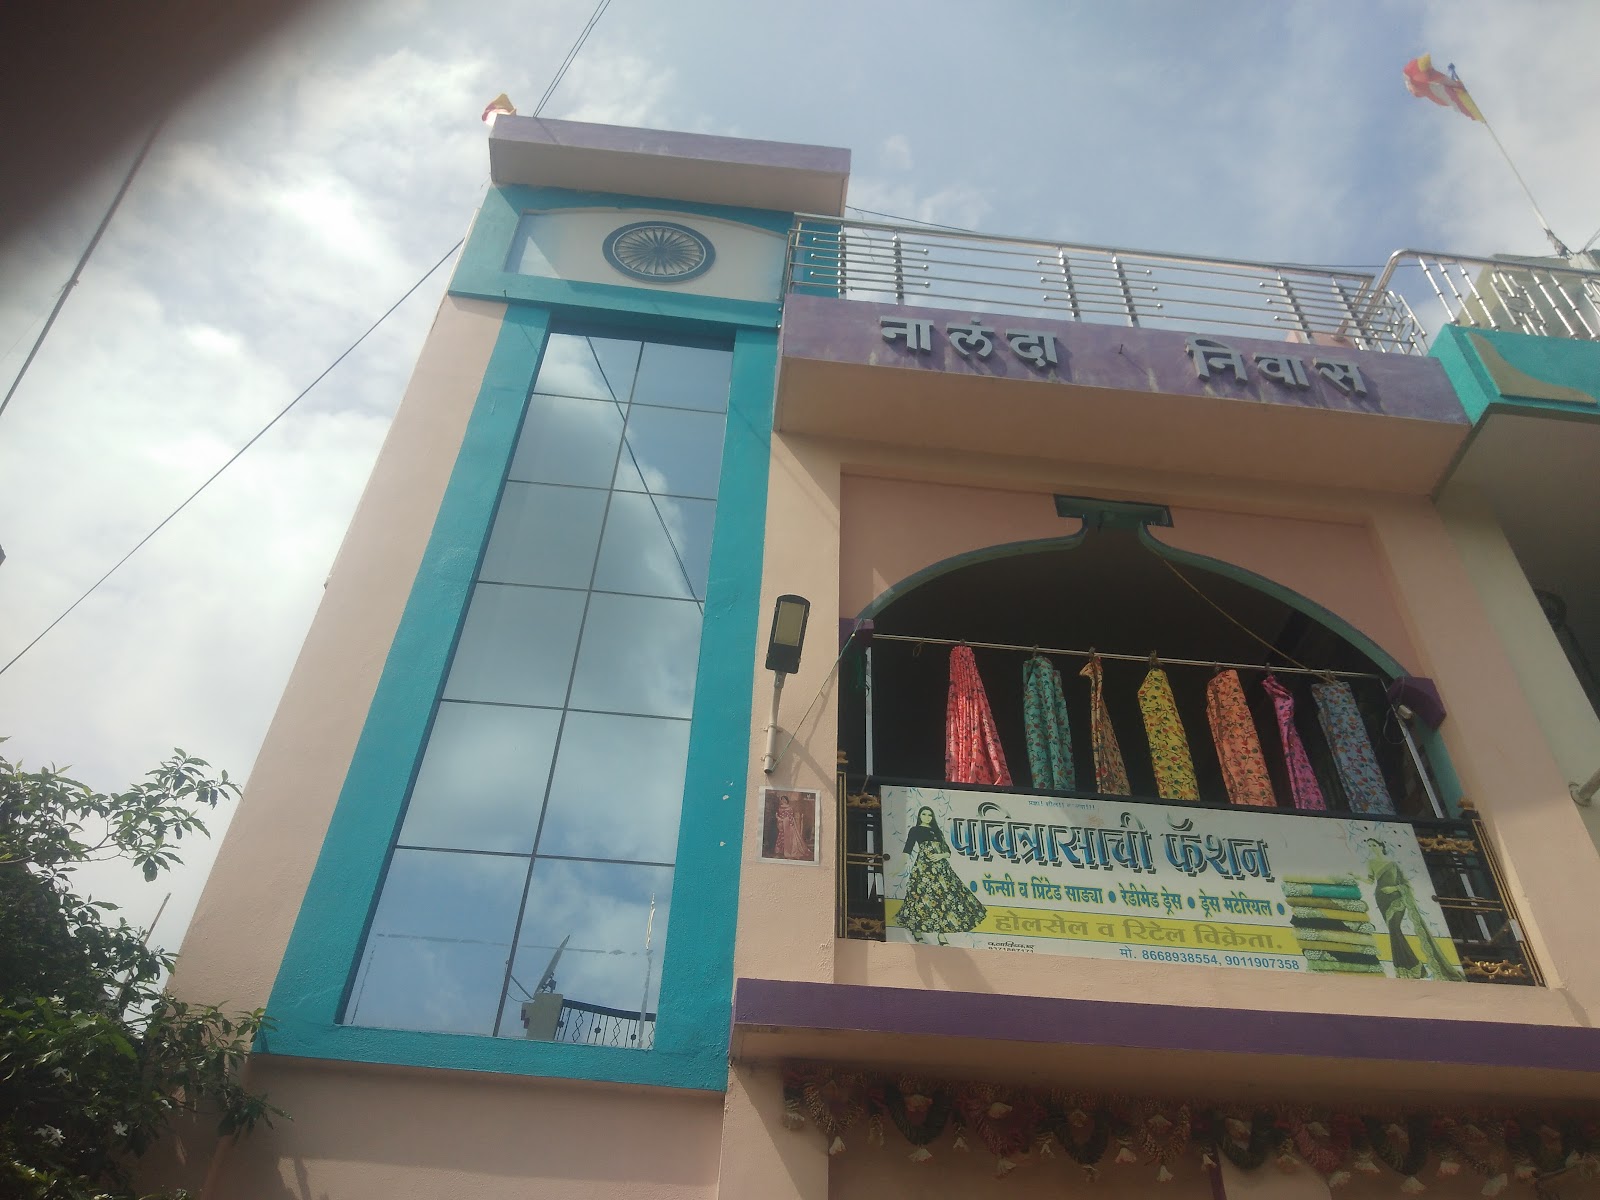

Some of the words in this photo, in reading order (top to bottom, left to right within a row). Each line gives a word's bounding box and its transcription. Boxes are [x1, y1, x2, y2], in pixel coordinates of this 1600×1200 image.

[880, 315, 1058, 367] नालंदा
[1184, 334, 1367, 396] निवास
[948, 801, 1156, 874] पवित्रासाची
[1160, 811, 1275, 882] फॅशन
[982, 873, 1015, 897] फॅन्सी
[1018, 882, 1028, 898] व
[1031, 876, 1062, 900] प्रिंटेड
[1064, 885, 1103, 904] साड्या
[1118, 882, 1159, 908] रेडीमेड
[1161, 886, 1183, 915] ड्रेस
[1199, 888, 1222, 917] ड्रेस
[1222, 890, 1272, 916] मटेरियल
[993, 910, 1088, 935] होलसेल
[1096, 922, 1114, 937] व
[1122, 918, 1186, 943] रिटेल
[1193, 923, 1282, 949] विक्रेता.
[1119, 945, 1137, 959] मो.
[1142, 950, 1222, 966] 8668938554,
[1225, 955, 1300, 970] 9011907358
